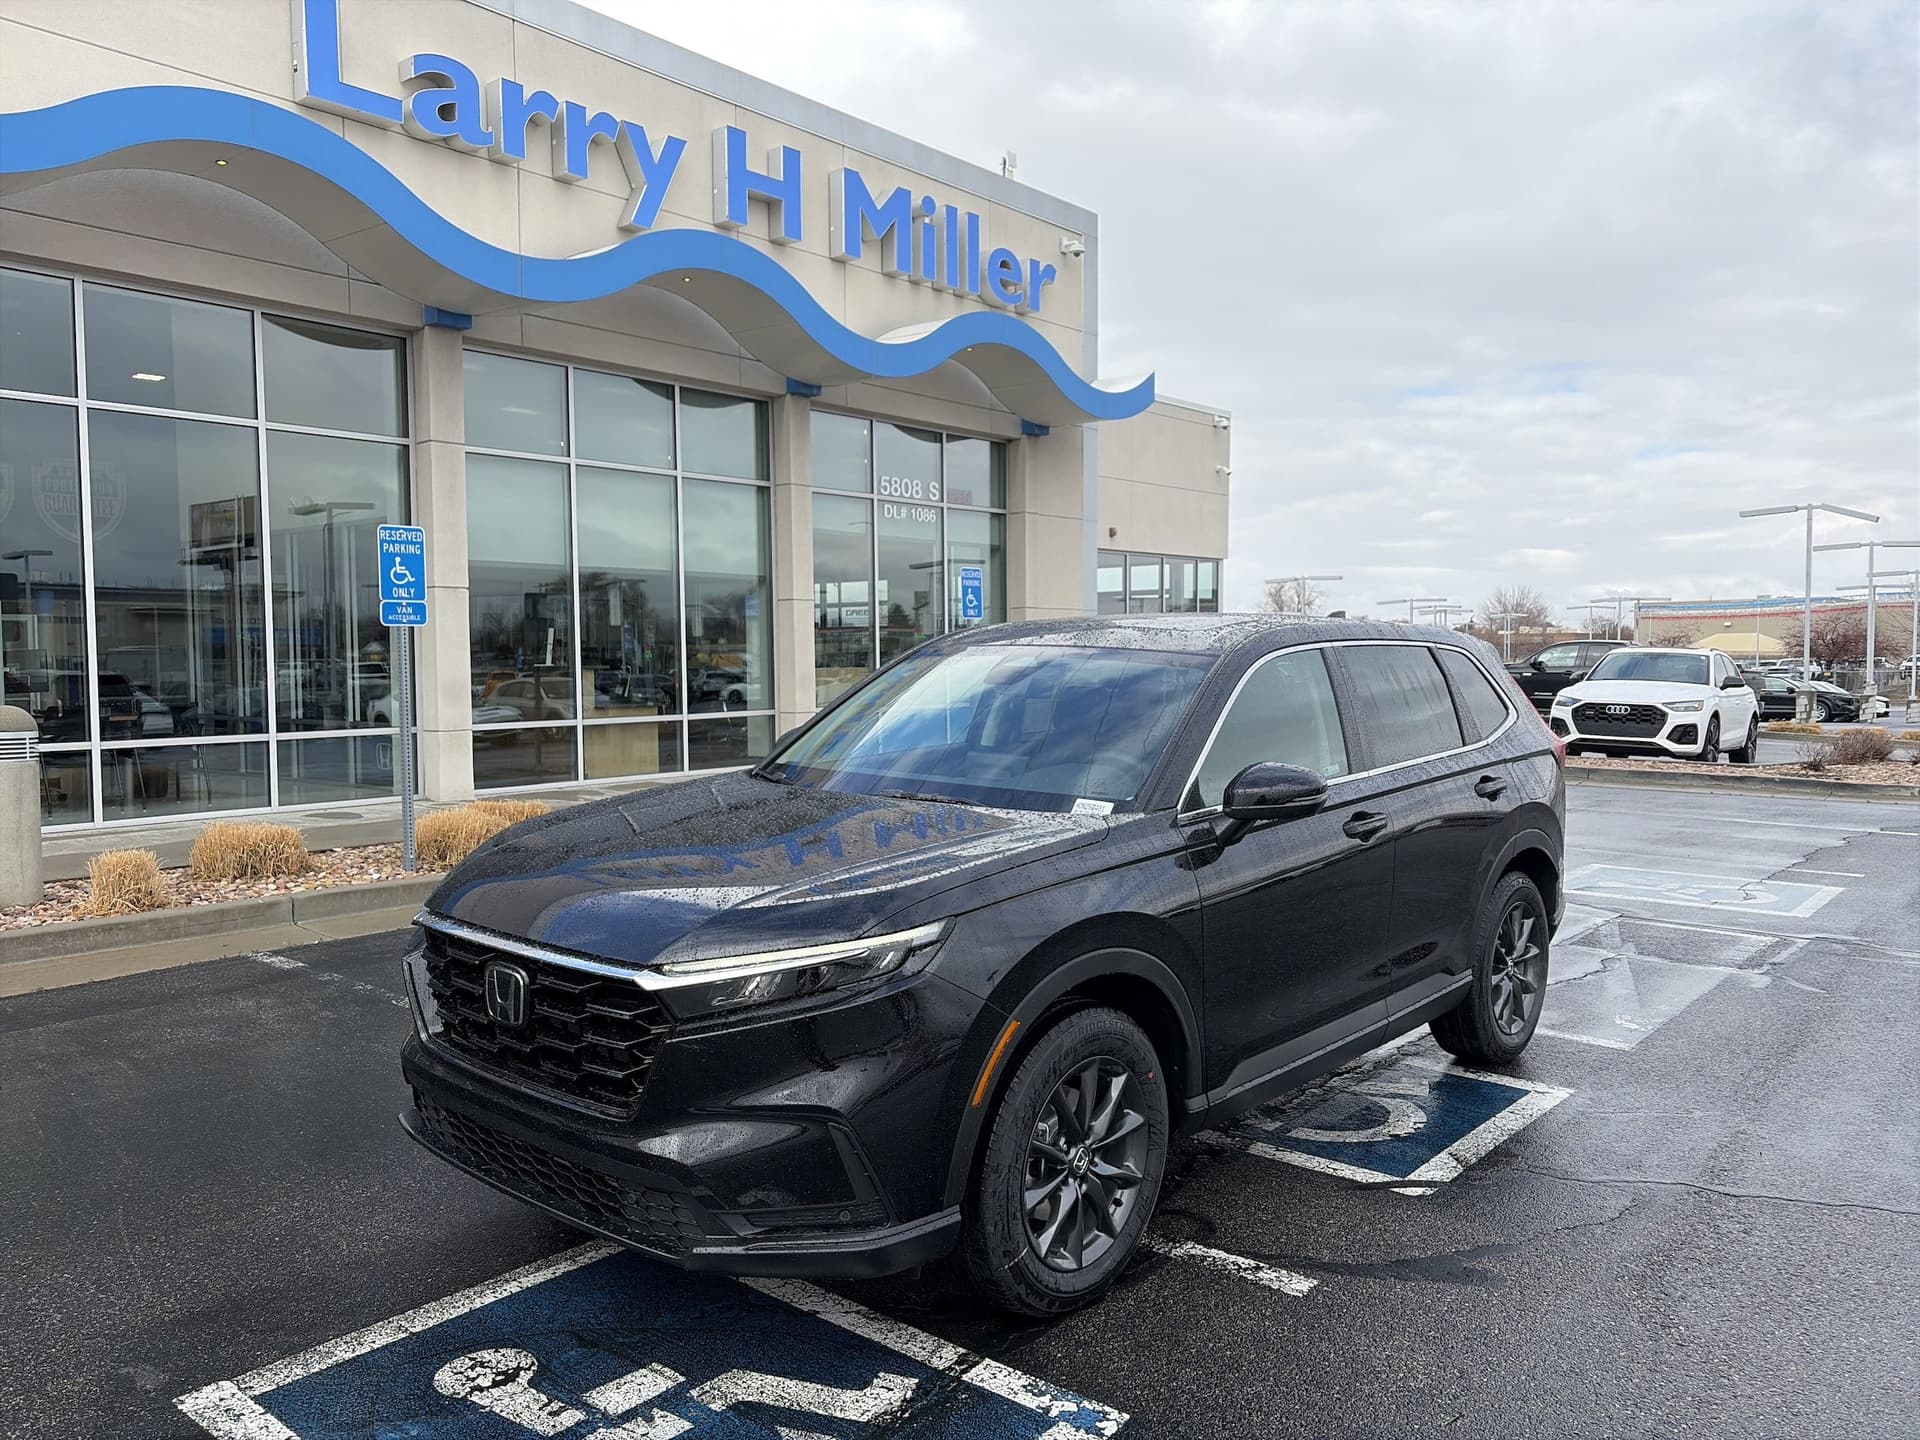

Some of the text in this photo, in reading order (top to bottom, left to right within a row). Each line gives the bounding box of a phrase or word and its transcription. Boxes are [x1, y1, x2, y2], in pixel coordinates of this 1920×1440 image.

[303, 0, 1057, 312] Larry H Miller
[880, 475, 940, 501] 5808 S
[884, 503, 937, 523] DL# 1086
[380, 529, 423, 542] RESERVED
[383, 543, 421, 555] PARKING
[392, 587, 416, 598] ONLY
[396, 606, 413, 614] VAN
